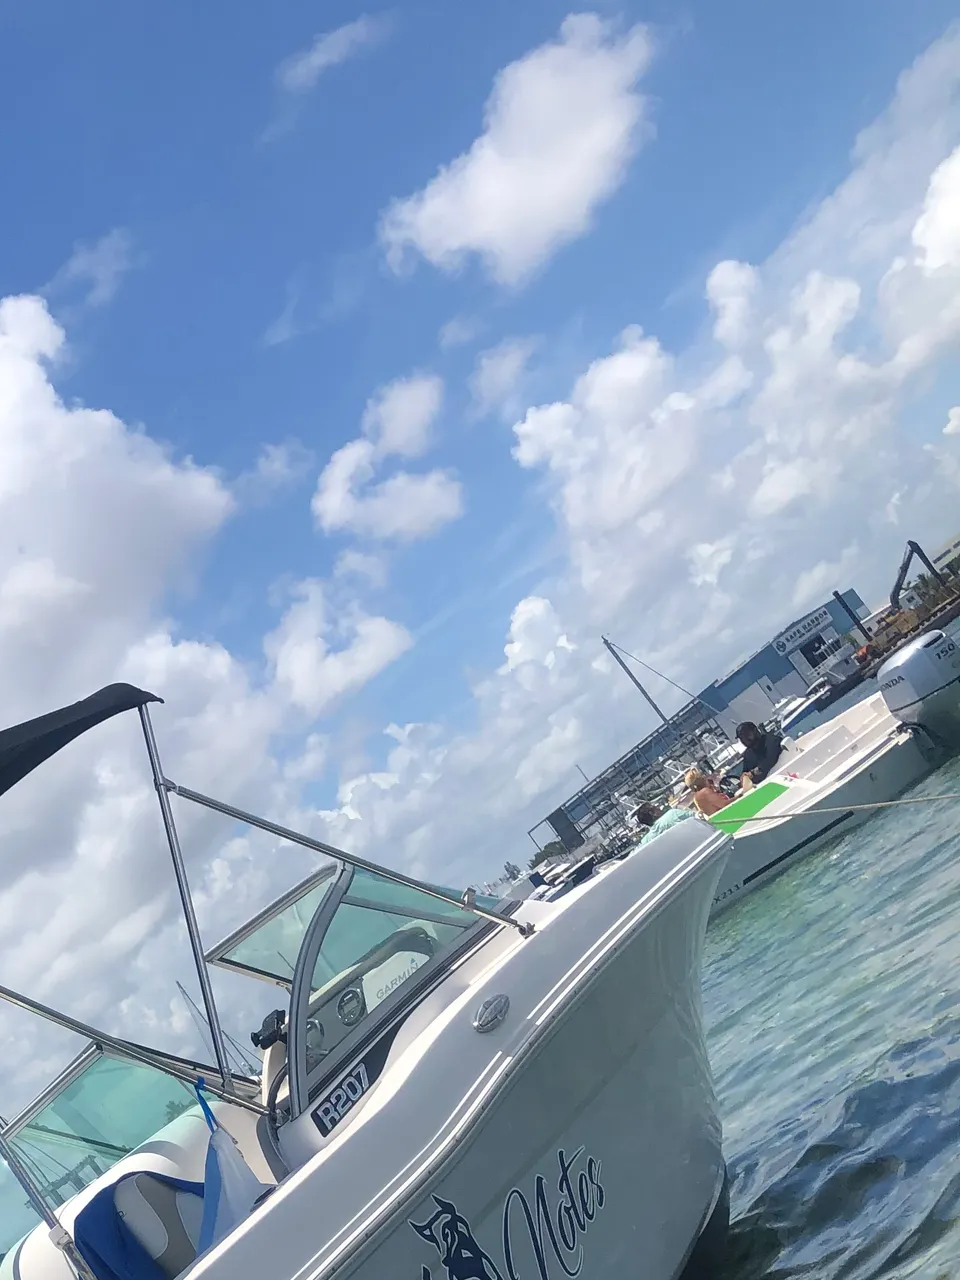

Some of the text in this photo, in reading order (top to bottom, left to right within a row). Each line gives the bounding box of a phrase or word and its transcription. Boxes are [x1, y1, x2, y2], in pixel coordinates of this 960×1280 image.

[785, 628, 801, 643] SAFE
[801, 610, 828, 630] HARBOR
[935, 643, 955, 660] 150
[880, 675, 905, 691] ONDA
[711, 884, 740, 906] X211
[376, 962, 419, 999] GARMIN
[316, 1062, 370, 1131] R207
